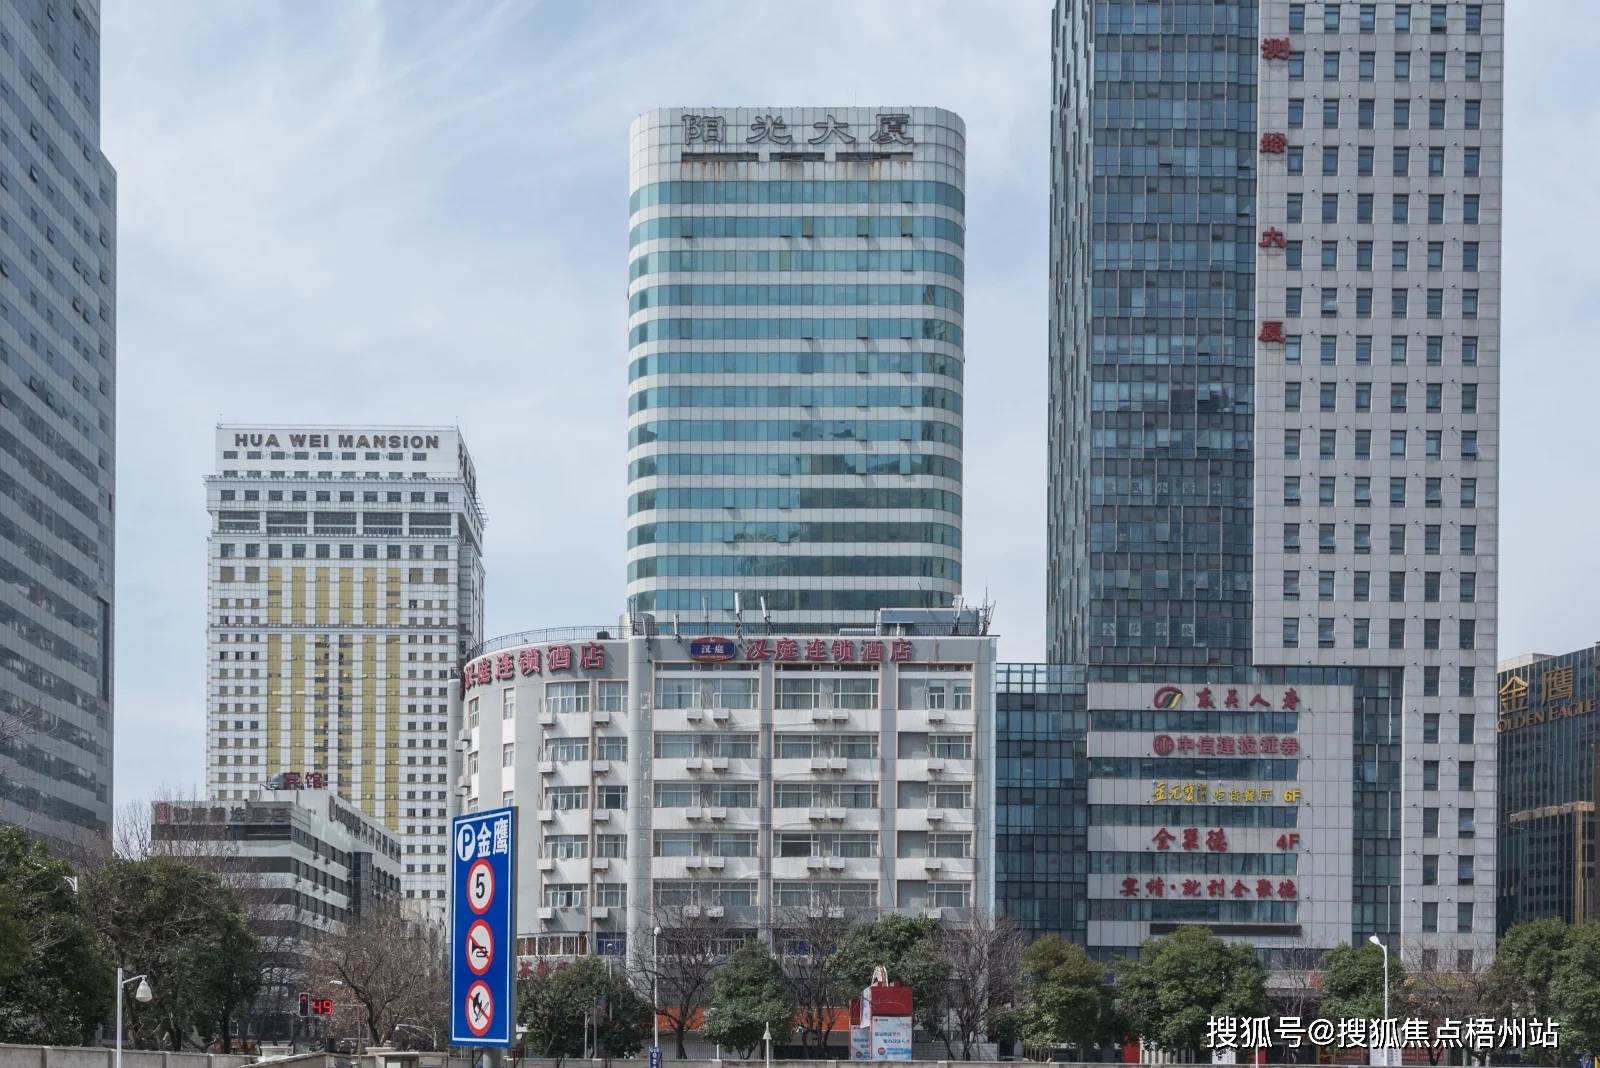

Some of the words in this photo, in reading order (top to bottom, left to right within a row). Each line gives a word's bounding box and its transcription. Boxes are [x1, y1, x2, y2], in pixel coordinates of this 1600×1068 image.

[681, 114, 914, 145] 阳光大厦
[234, 433, 280, 448] HUA
[289, 433, 329, 448] WEI
[338, 434, 439, 449] MANSION
[701, 643, 724, 655] 汉庭
[745, 637, 914, 662] 汉庭连锁酒店
[464, 642, 606, 689] 汉庭连锁酒店
[1498, 665, 1574, 715] 金鹰
[1497, 710, 1545, 733] OLDEN
[1549, 698, 1597, 721] EAGLE
[1177, 735, 1299, 756] 中信建投证券
[1283, 790, 1301, 803] 6F
[476, 818, 509, 858] 金鹰
[1152, 828, 1228, 852] 全聚德
[1276, 833, 1300, 850] 4F
[475, 872, 486, 899] 5
[312, 1000, 333, 1015] 49
